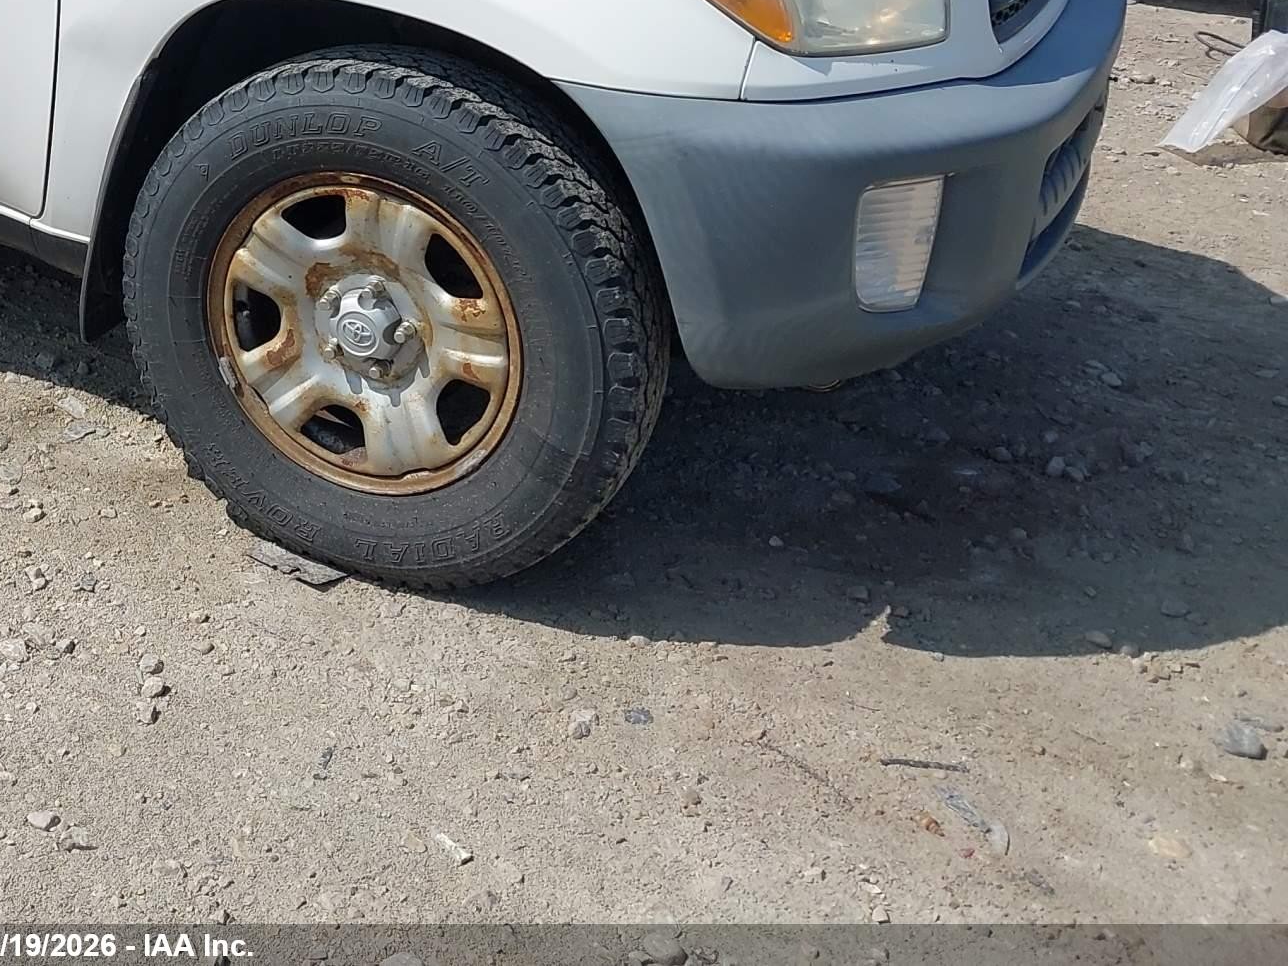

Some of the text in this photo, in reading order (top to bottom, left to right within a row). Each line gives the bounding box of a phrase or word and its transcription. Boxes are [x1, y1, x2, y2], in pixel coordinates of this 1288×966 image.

[228, 111, 490, 189] DUNLOP A/T
[199, 441, 511, 565] RADIAL ROVER
